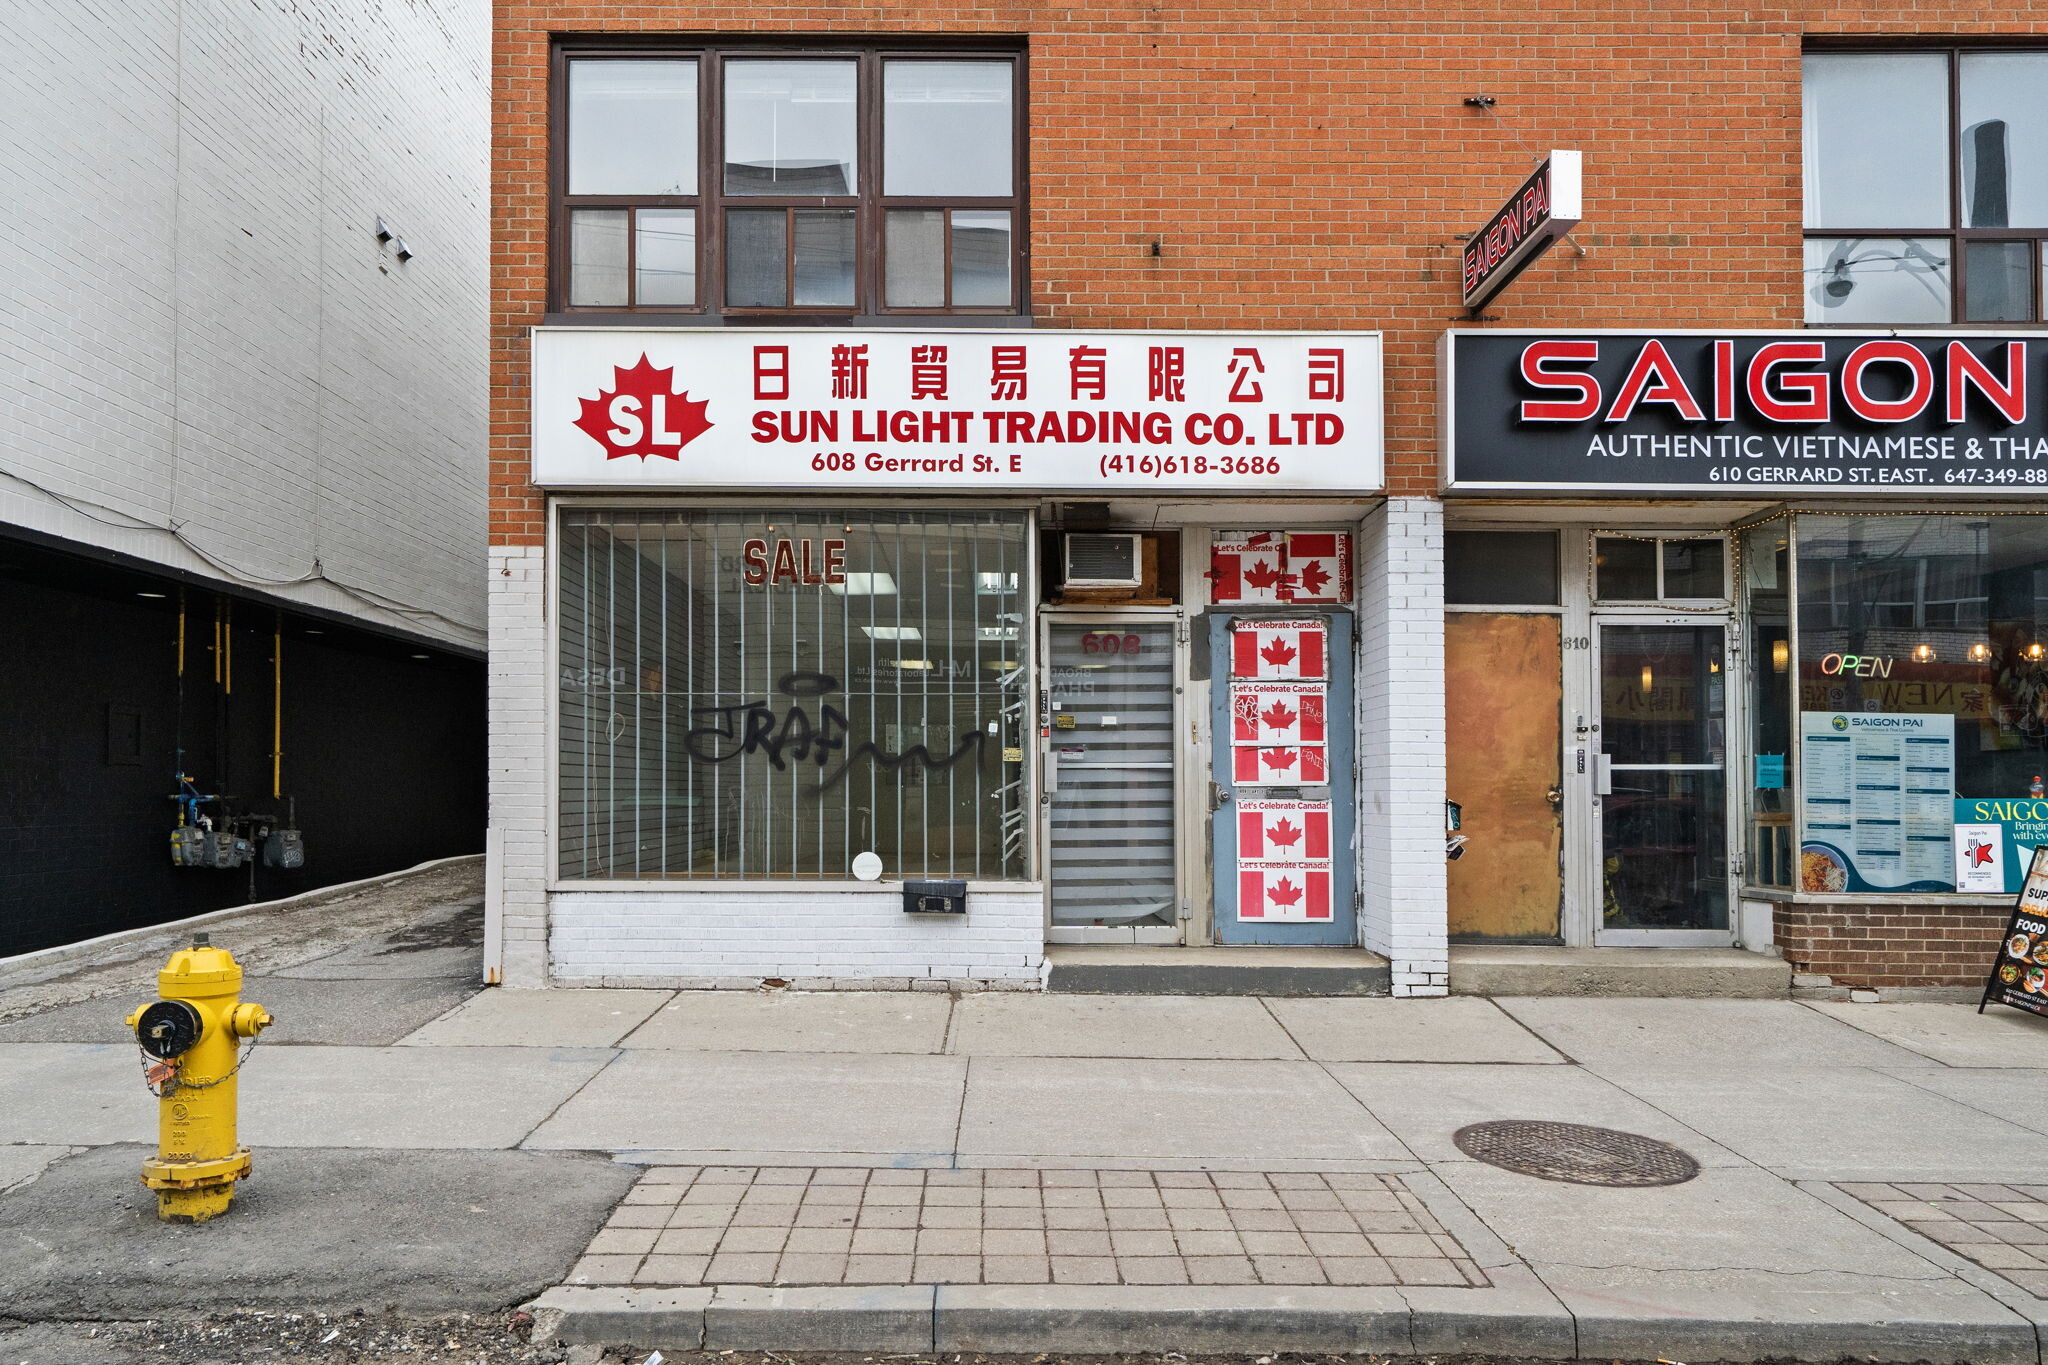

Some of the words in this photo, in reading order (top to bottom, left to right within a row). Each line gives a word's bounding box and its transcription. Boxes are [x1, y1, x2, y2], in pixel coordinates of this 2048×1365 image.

[1465, 200, 1521, 293] SAIGON
[753, 344, 1344, 403] 日新貿易有限公司
[1520, 338, 2028, 425] SAIGON
[606, 394, 682, 447] SL
[752, 410, 838, 444] SUN
[853, 410, 974, 444] LIGHT
[983, 411, 1172, 445] TRADING
[1185, 413, 1255, 446] CO.
[1269, 414, 1344, 446] LTD
[1587, 435, 1763, 459] AUTHENTIC
[1773, 436, 1955, 460] VIETNAMESE
[1965, 438, 1984, 460] &
[812, 453, 855, 472] 608
[865, 453, 963, 472] Gerrard
[973, 454, 1000, 473] St.
[1010, 455, 1022, 473] E
[1101, 455, 1281, 478] (416)618-3686
[1709, 466, 1742, 482] 610
[1747, 467, 1844, 483] GERRARD
[1217, 544, 1235, 552] Let's
[1236, 544, 1273, 552] Celebrate
[743, 539, 847, 586] SALE
[1338, 553, 1347, 589] Celebrate
[1253, 621, 1290, 629] Celebrate
[1292, 621, 1323, 629] Canada!
[1081, 634, 1141, 656] 608
[1563, 637, 1589, 651] 610
[1821, 653, 1894, 679] OPEN
[1234, 684, 1252, 693] Let's
[1254, 684, 1290, 693] Celebrate
[1292, 684, 1323, 693] Canada!
[1852, 717, 1900, 728] SAIGON
[1903, 719, 1923, 728] PAI
[1239, 802, 1257, 810] Let's
[1259, 802, 1296, 810] Celebrate
[1298, 802, 1329, 810] Canada!
[2012, 830, 2034, 840] with
[2035, 832, 2048, 840] ev
[2016, 918, 2046, 935] FOOD
